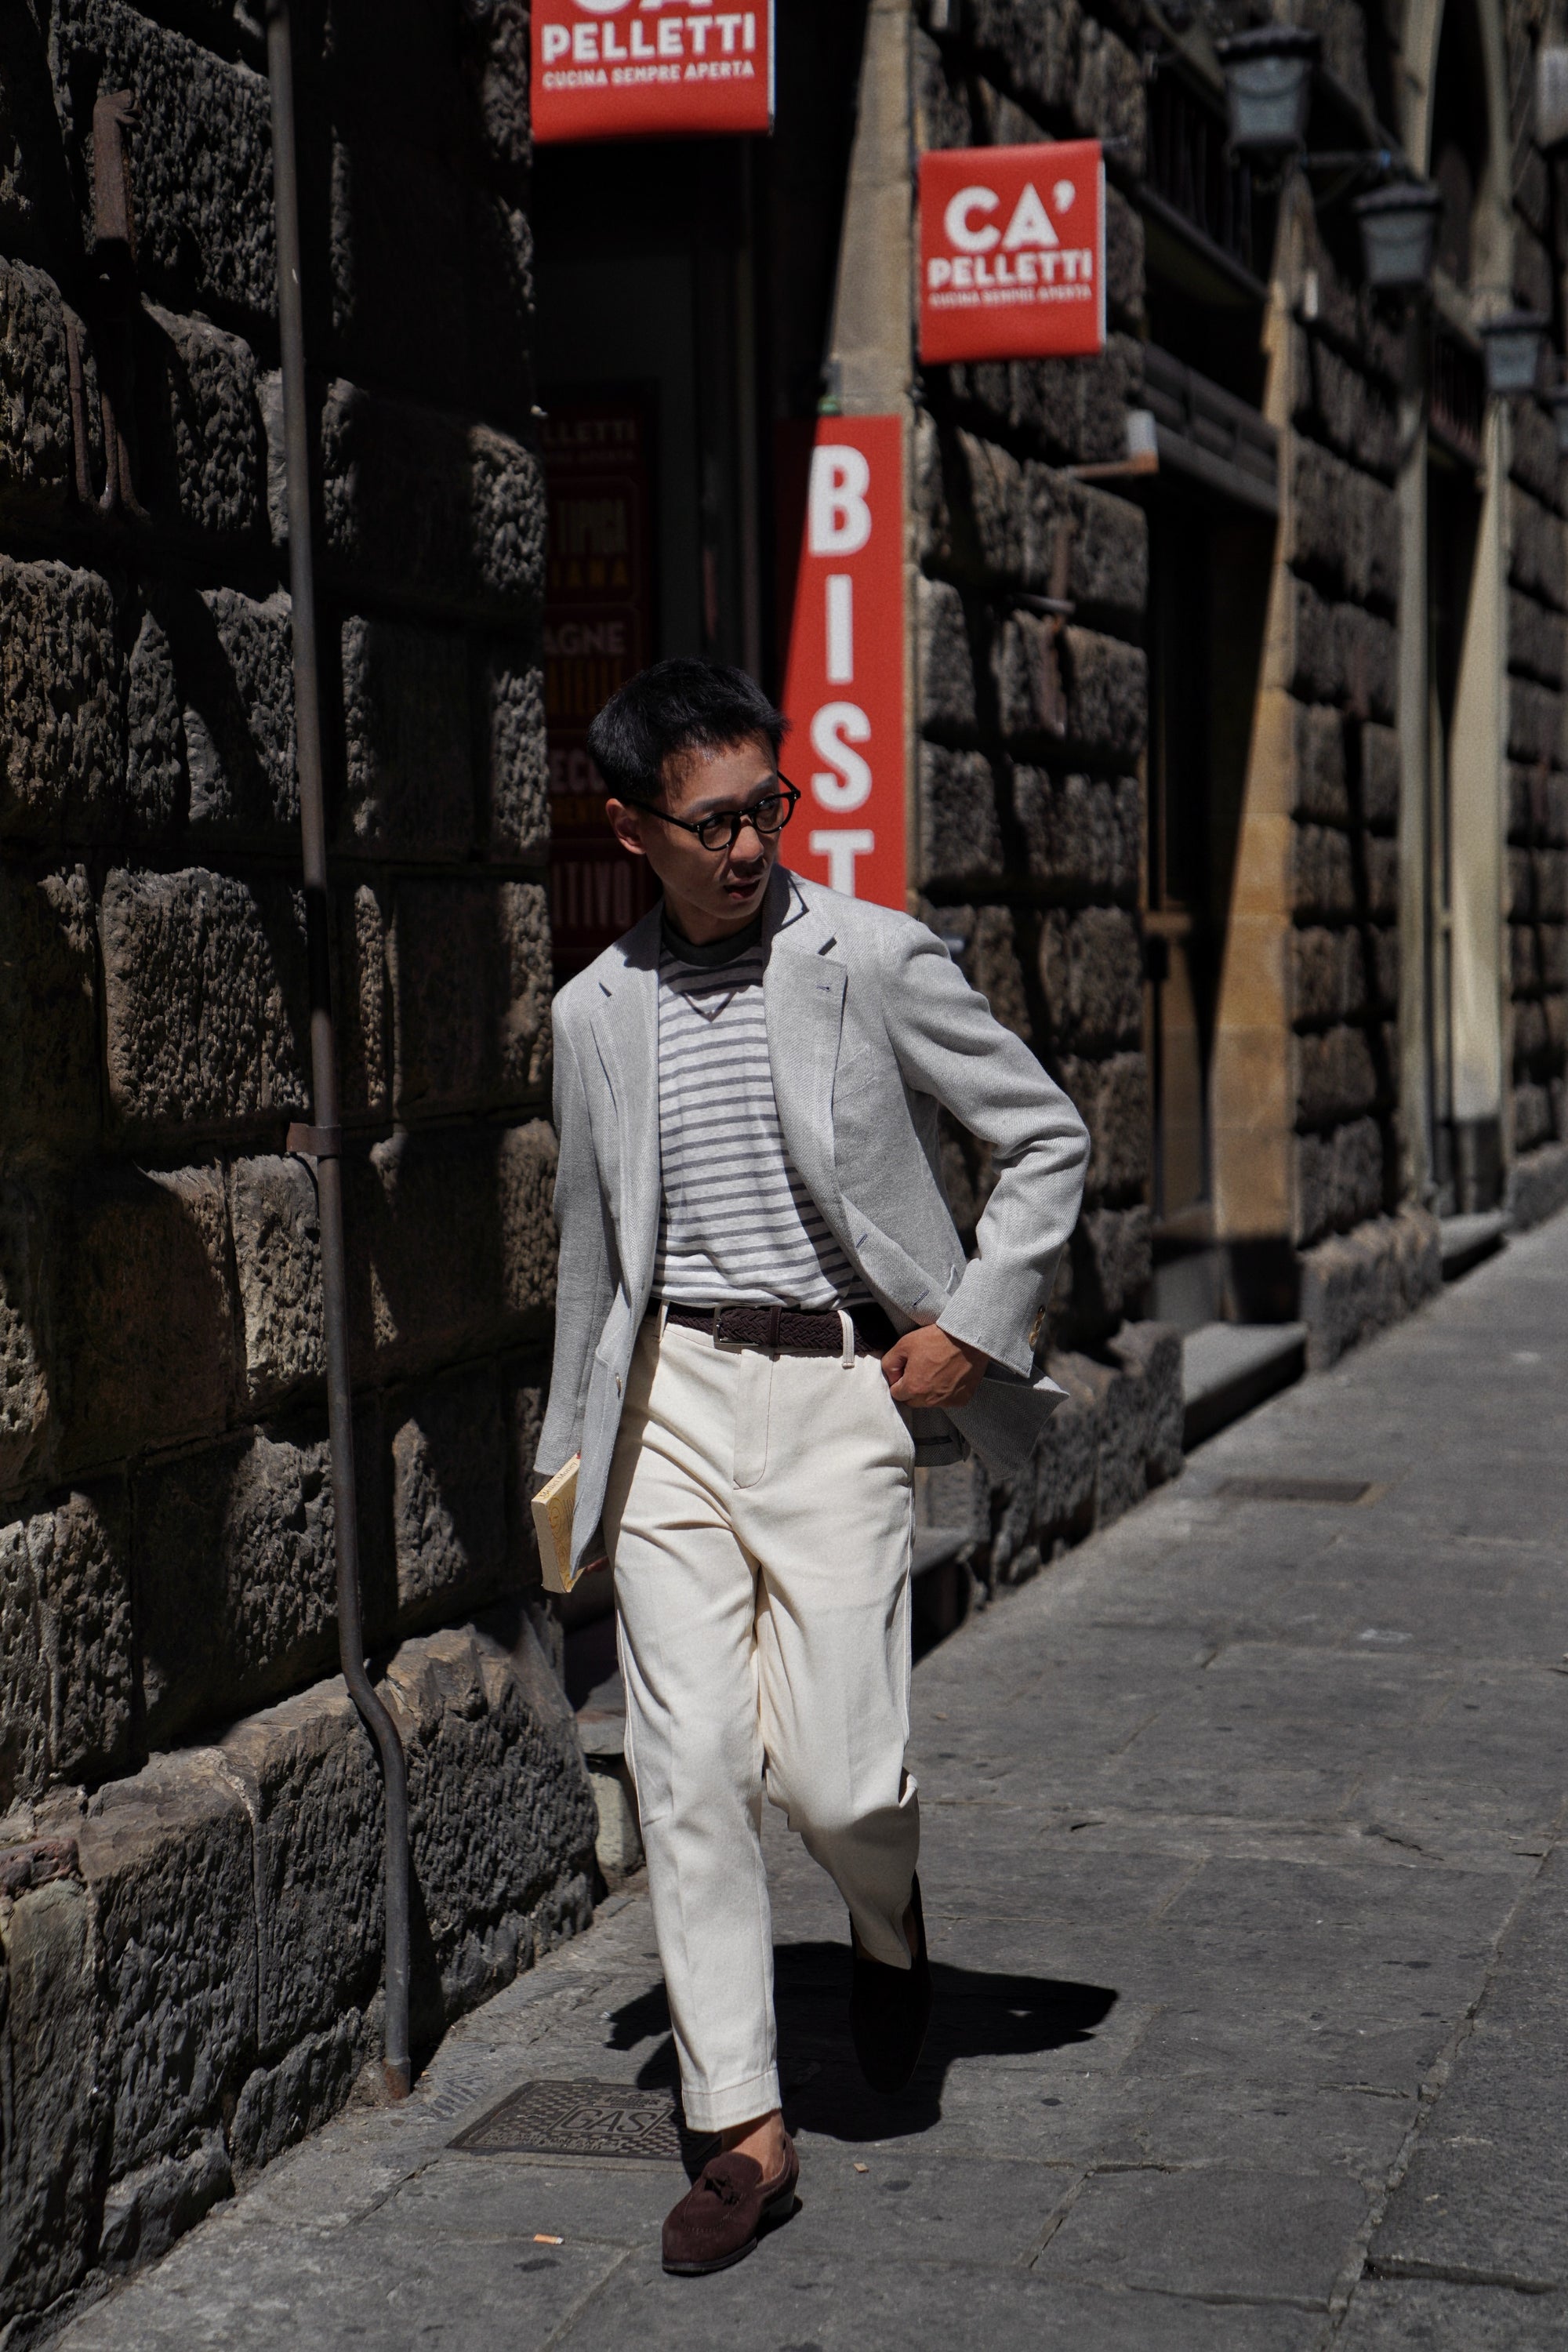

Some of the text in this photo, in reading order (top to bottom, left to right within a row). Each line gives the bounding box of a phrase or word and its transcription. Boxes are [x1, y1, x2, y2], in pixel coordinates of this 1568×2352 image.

[541, 12, 756, 64] PELLETTI
[542, 60, 755, 91] CUCINA SEMPRE APERTA
[944, 179, 1076, 254] CA'
[927, 248, 1093, 290] PELLETTI
[556, 1461, 578, 1480] Money
[560, 2107, 659, 2133] GAS
